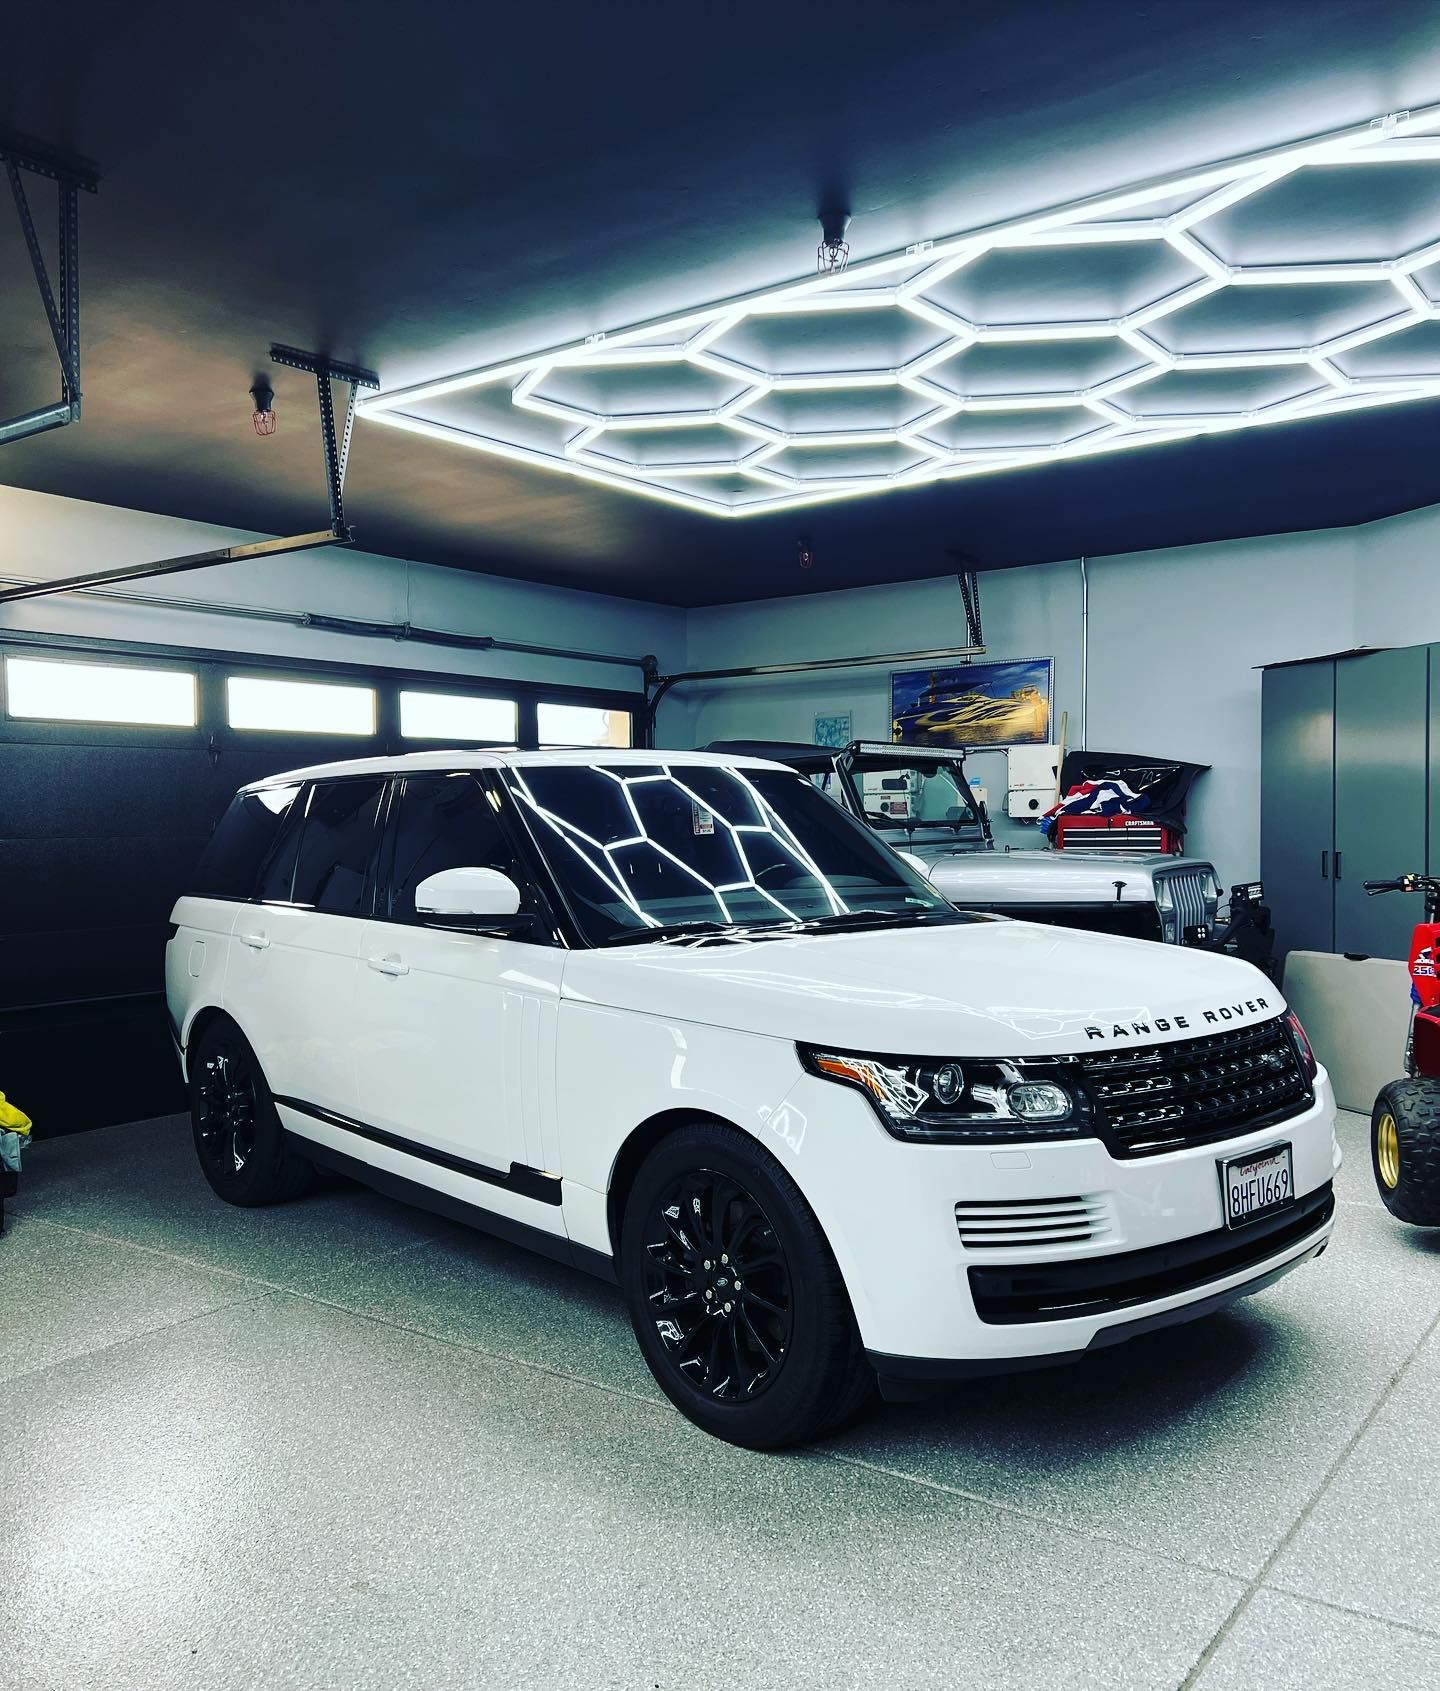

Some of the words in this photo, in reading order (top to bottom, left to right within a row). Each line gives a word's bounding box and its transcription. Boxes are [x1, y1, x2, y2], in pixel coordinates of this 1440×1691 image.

[1085, 1016, 1190, 1039] RANGE
[1202, 998, 1269, 1024] ROVER
[1232, 1169, 1288, 1215] 8HFU669
